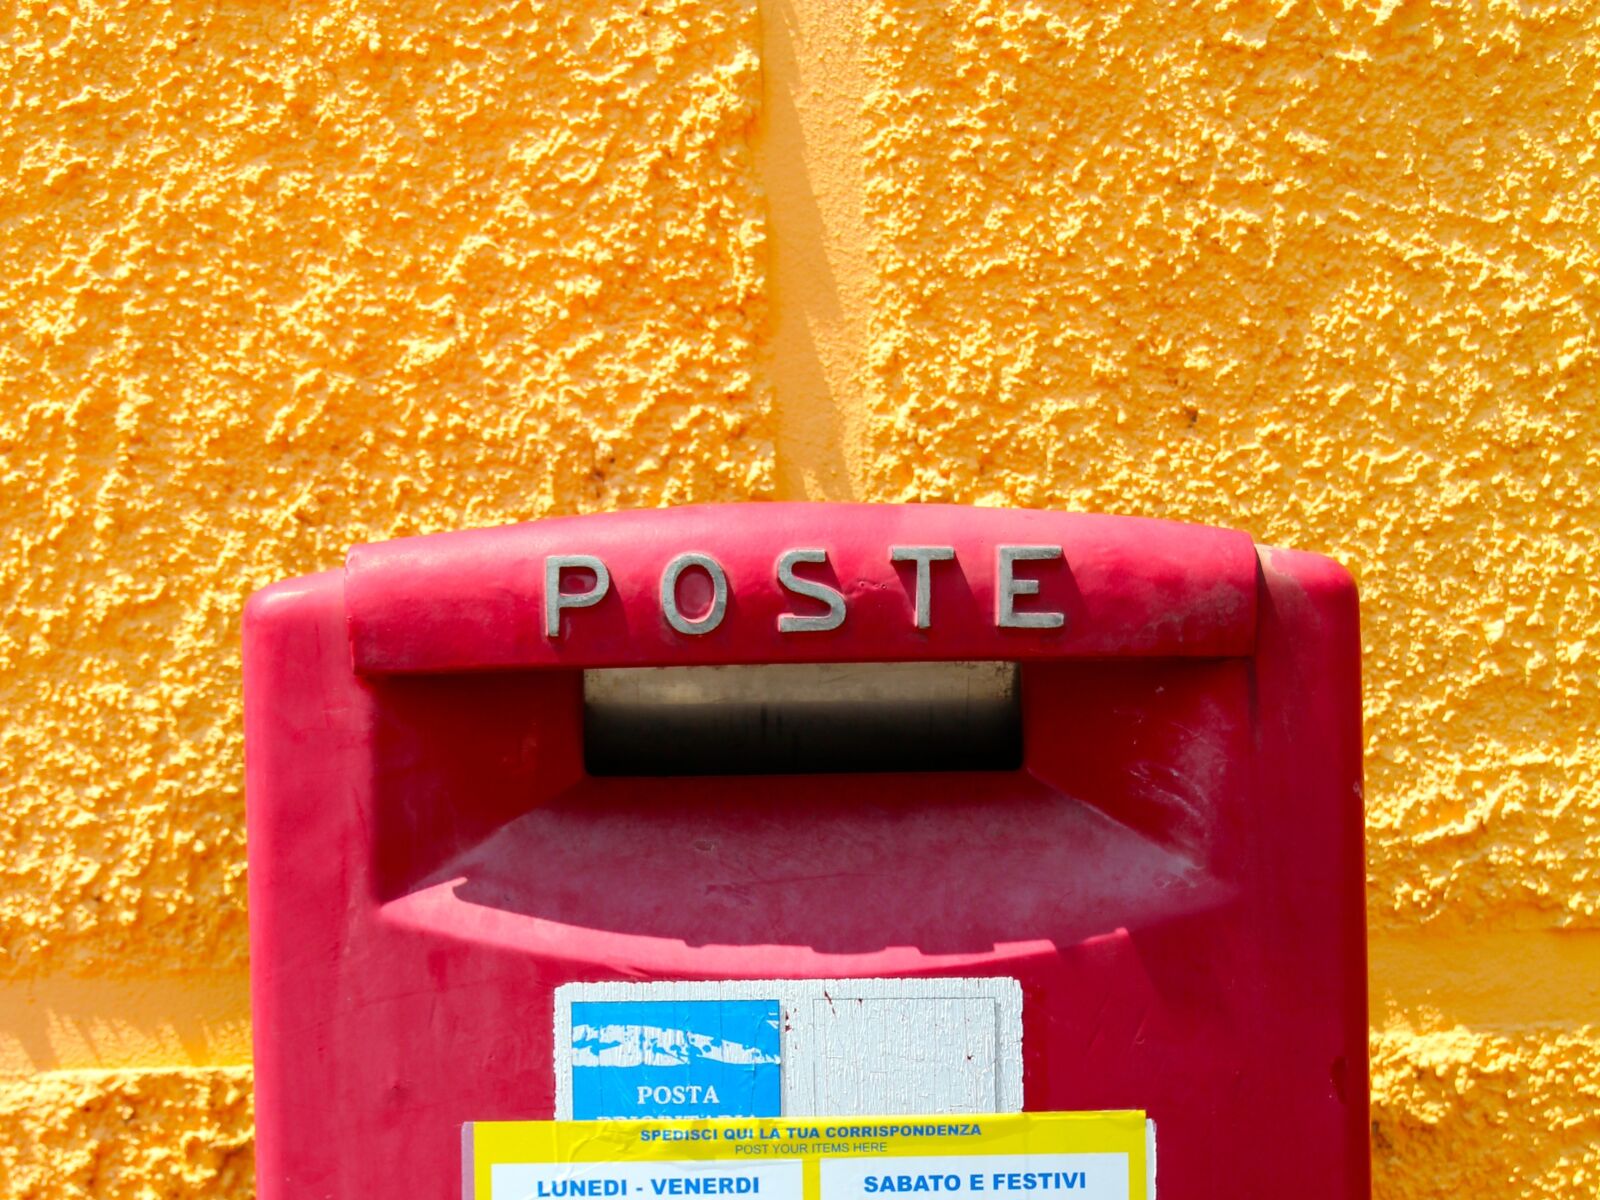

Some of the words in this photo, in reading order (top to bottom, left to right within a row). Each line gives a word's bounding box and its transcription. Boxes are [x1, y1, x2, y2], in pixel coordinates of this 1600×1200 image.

[544, 545, 1066, 638] POSTE
[636, 1084, 720, 1105] POSTA
[640, 1128, 718, 1141] SPEDISCI
[723, 1128, 753, 1140] QUI
[759, 1128, 781, 1140] LA
[786, 1127, 820, 1139] TUA
[825, 1124, 982, 1138] CORRISPONDENZA
[735, 1145, 768, 1155] POST
[772, 1143, 808, 1154] YOUR
[811, 1143, 850, 1153] ITEMS
[853, 1142, 888, 1152] HERE
[537, 1179, 628, 1198] LUNEDI
[650, 1176, 760, 1196] VENERDI
[864, 1174, 961, 1193] SABATO
[969, 1174, 984, 1191] E
[993, 1172, 1087, 1190] FESTIVI
